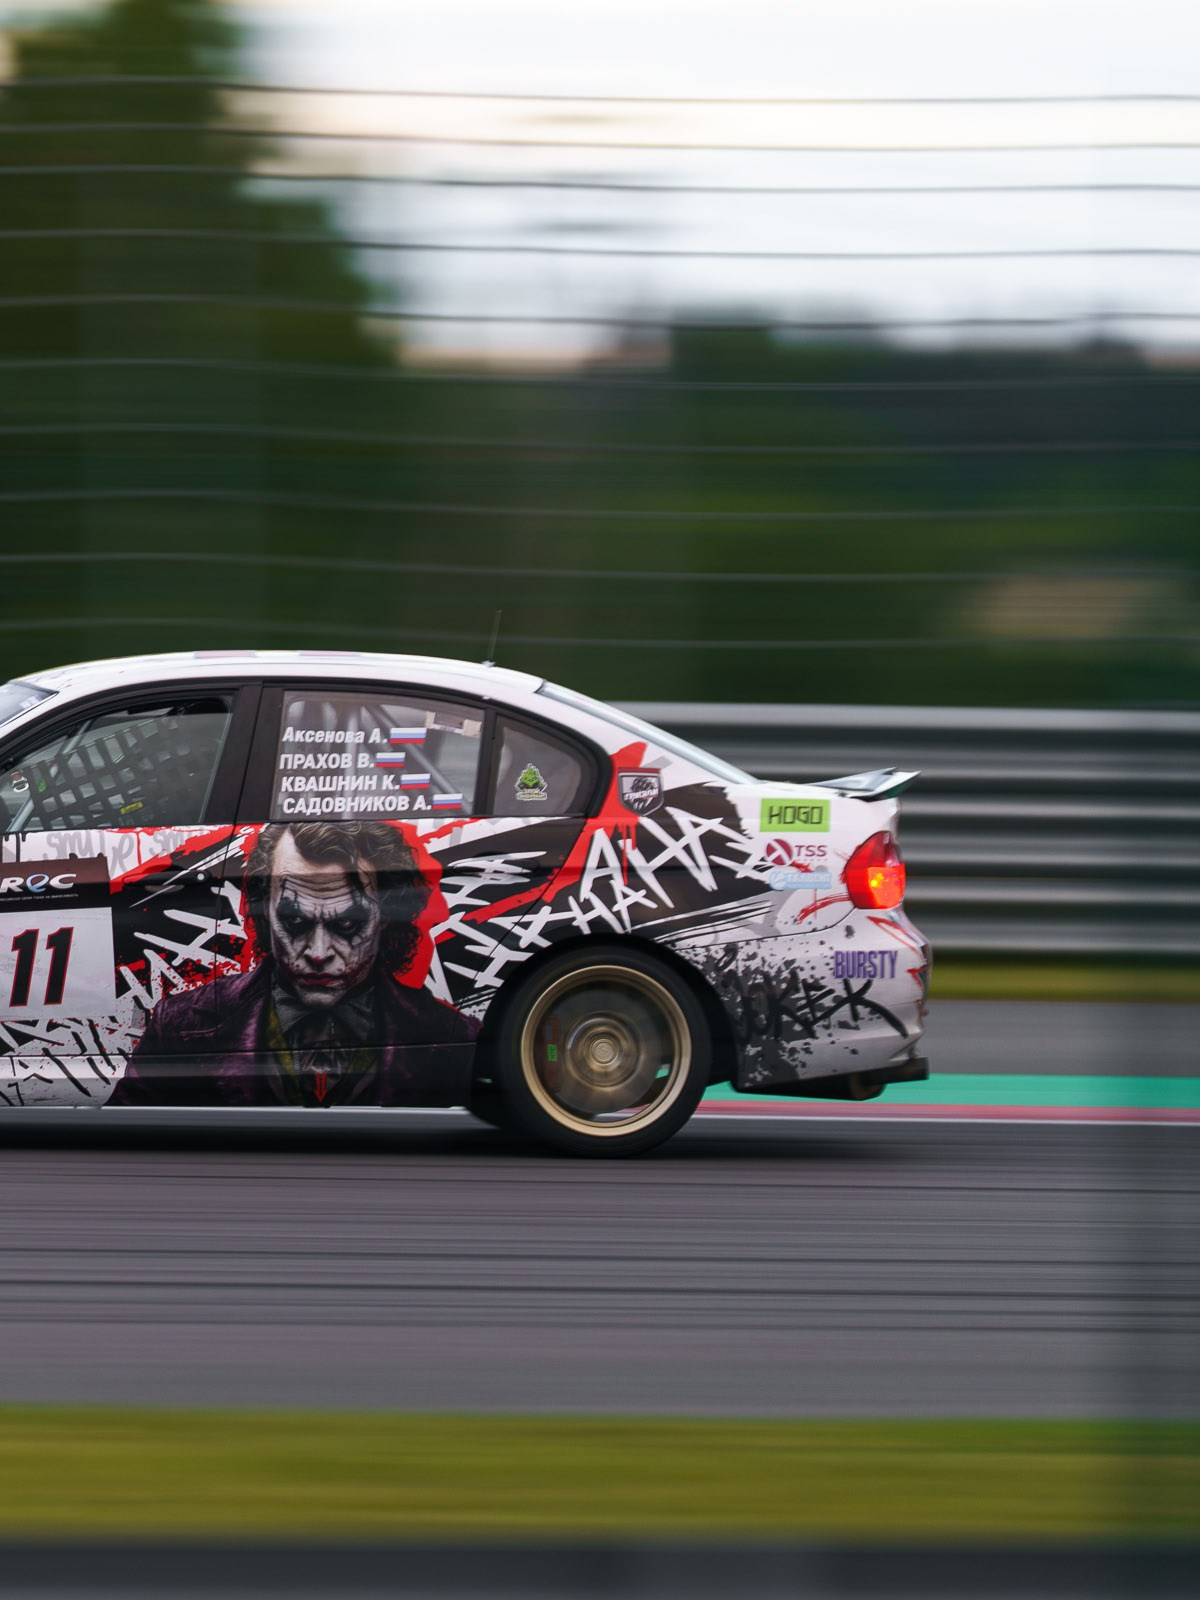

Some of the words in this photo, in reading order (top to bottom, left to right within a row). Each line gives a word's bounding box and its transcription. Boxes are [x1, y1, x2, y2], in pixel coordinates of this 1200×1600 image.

[282, 727, 364, 743] Аксенова
[368, 728, 388, 743] А.
[279, 753, 352, 769] ПРАХОВ
[358, 753, 375, 768] В.
[281, 776, 377, 792] КВАШНИН
[382, 775, 400, 790] К.
[282, 796, 410, 816] САДОВНИКОВ
[413, 795, 431, 810] А.
[768, 805, 823, 824] HOGO
[794, 845, 828, 857] TSS
[9, 926, 74, 1007] 11
[834, 951, 898, 979] BURSTY
